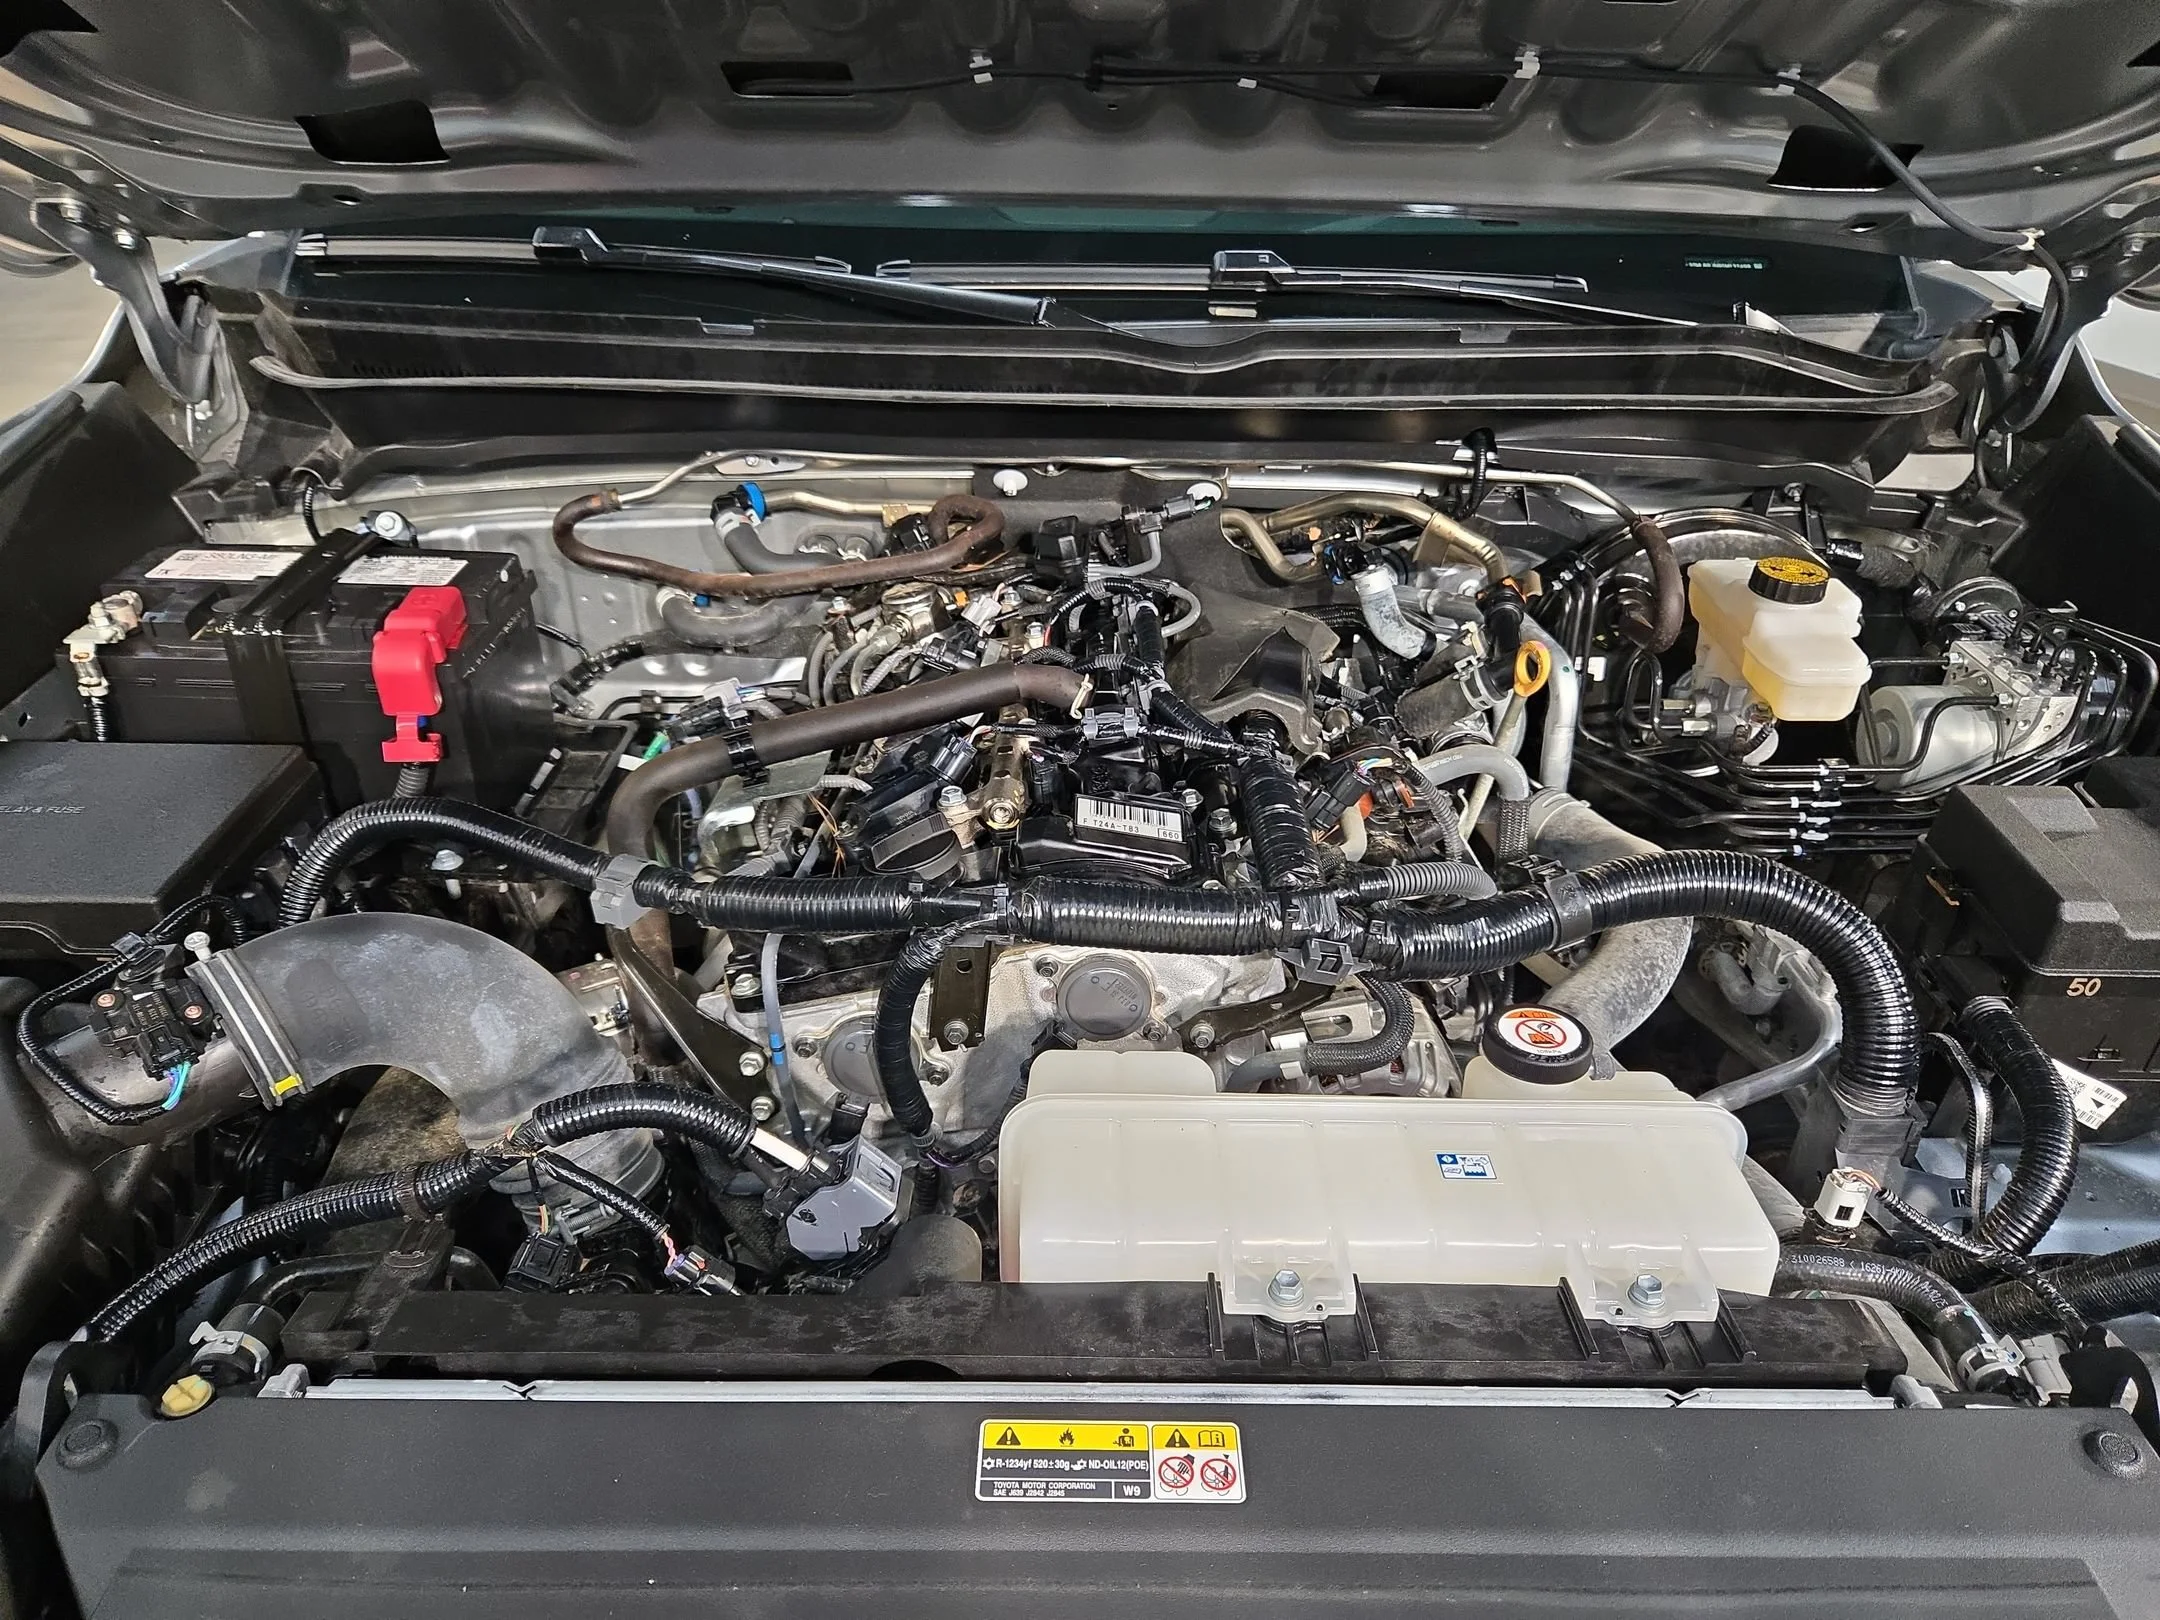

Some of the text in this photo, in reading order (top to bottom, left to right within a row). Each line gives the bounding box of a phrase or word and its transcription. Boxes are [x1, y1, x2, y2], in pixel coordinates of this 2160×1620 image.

[45, 805, 86, 814] FUSE
[1162, 830, 1180, 840] 660
[2066, 977, 2102, 997] 50
[995, 1458, 1032, 1470] R-1234yf
[1088, 1459, 1149, 1472] ND-OIL12(POE)
[993, 1481, 1096, 1490] TOYOTA MOTOR CORPORATION
[1122, 1485, 1141, 1497] W9
